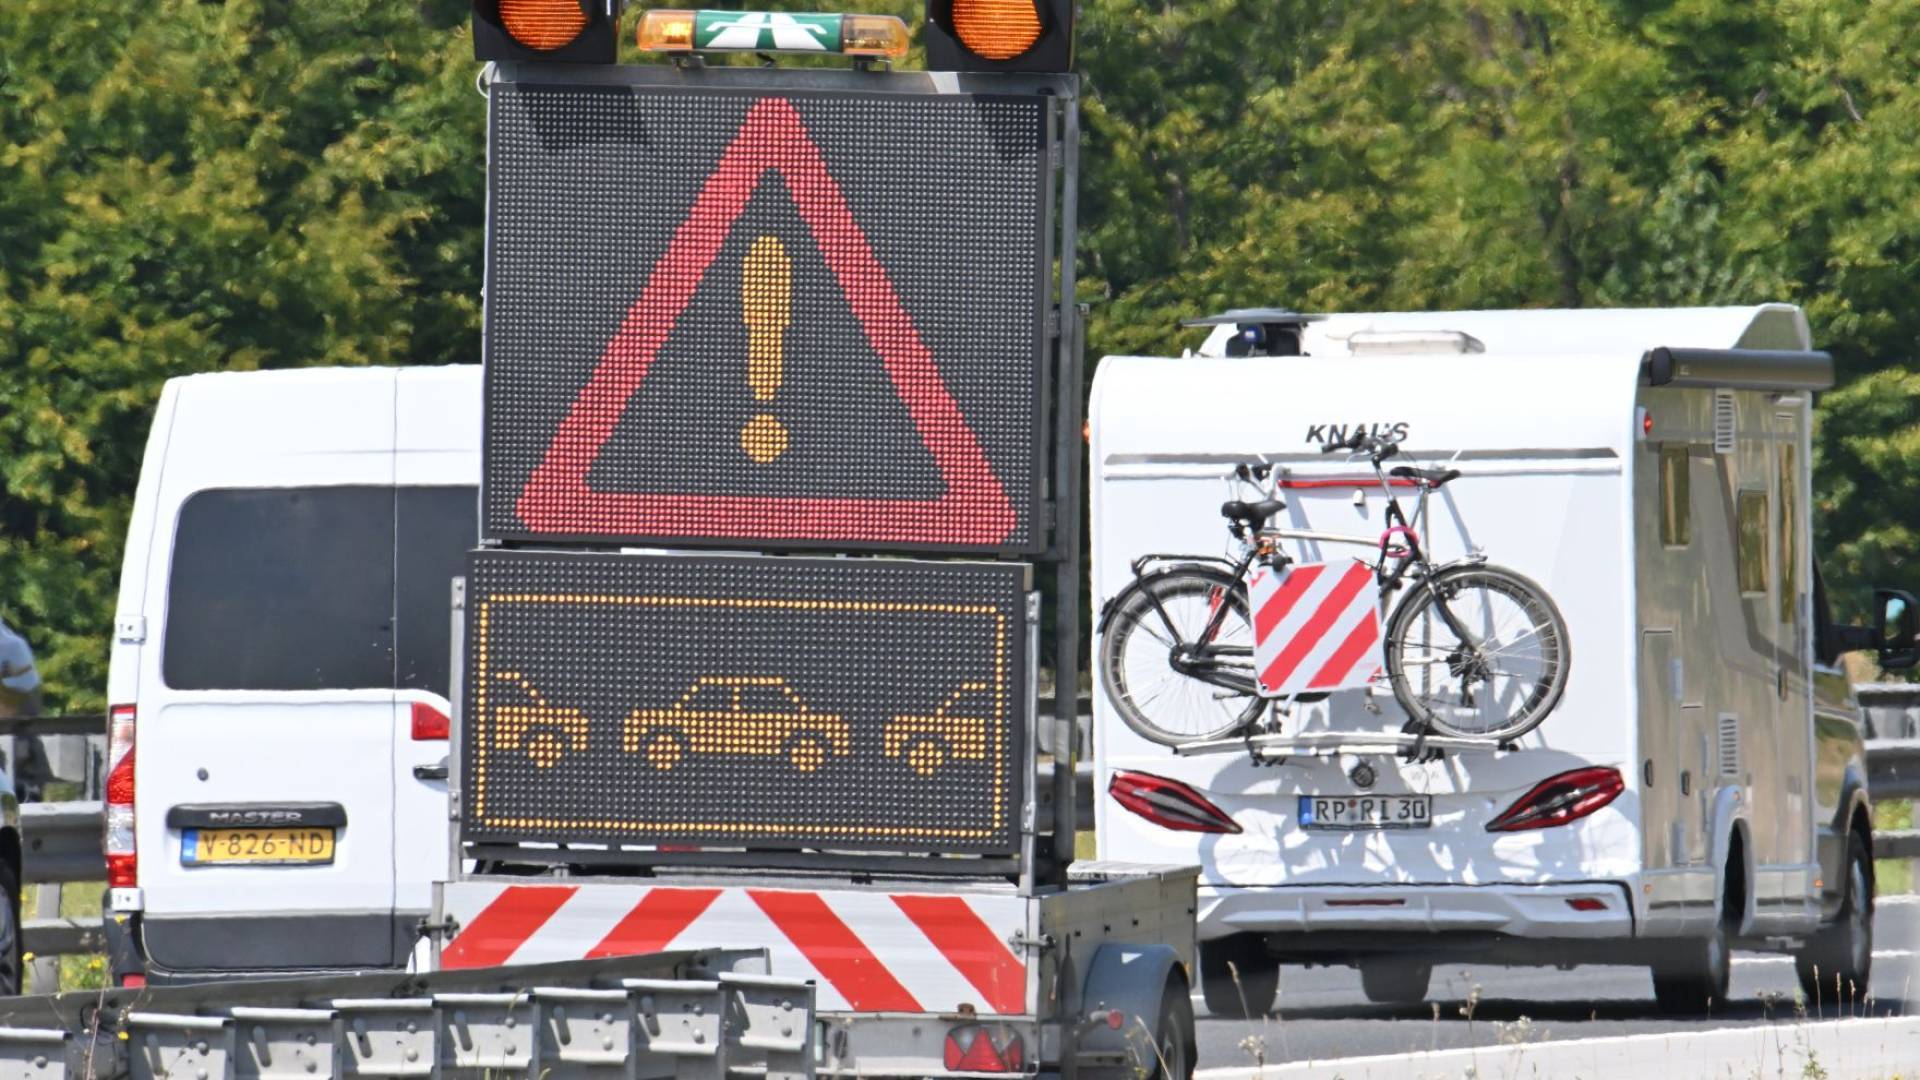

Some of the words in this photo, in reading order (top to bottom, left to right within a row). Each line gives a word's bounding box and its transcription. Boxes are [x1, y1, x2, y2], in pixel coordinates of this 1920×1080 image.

[208, 811, 303, 824] MASTER
[1315, 800, 1346, 821] RP
[1397, 800, 1426, 820] 30
[203, 833, 325, 856] V-826-ND
